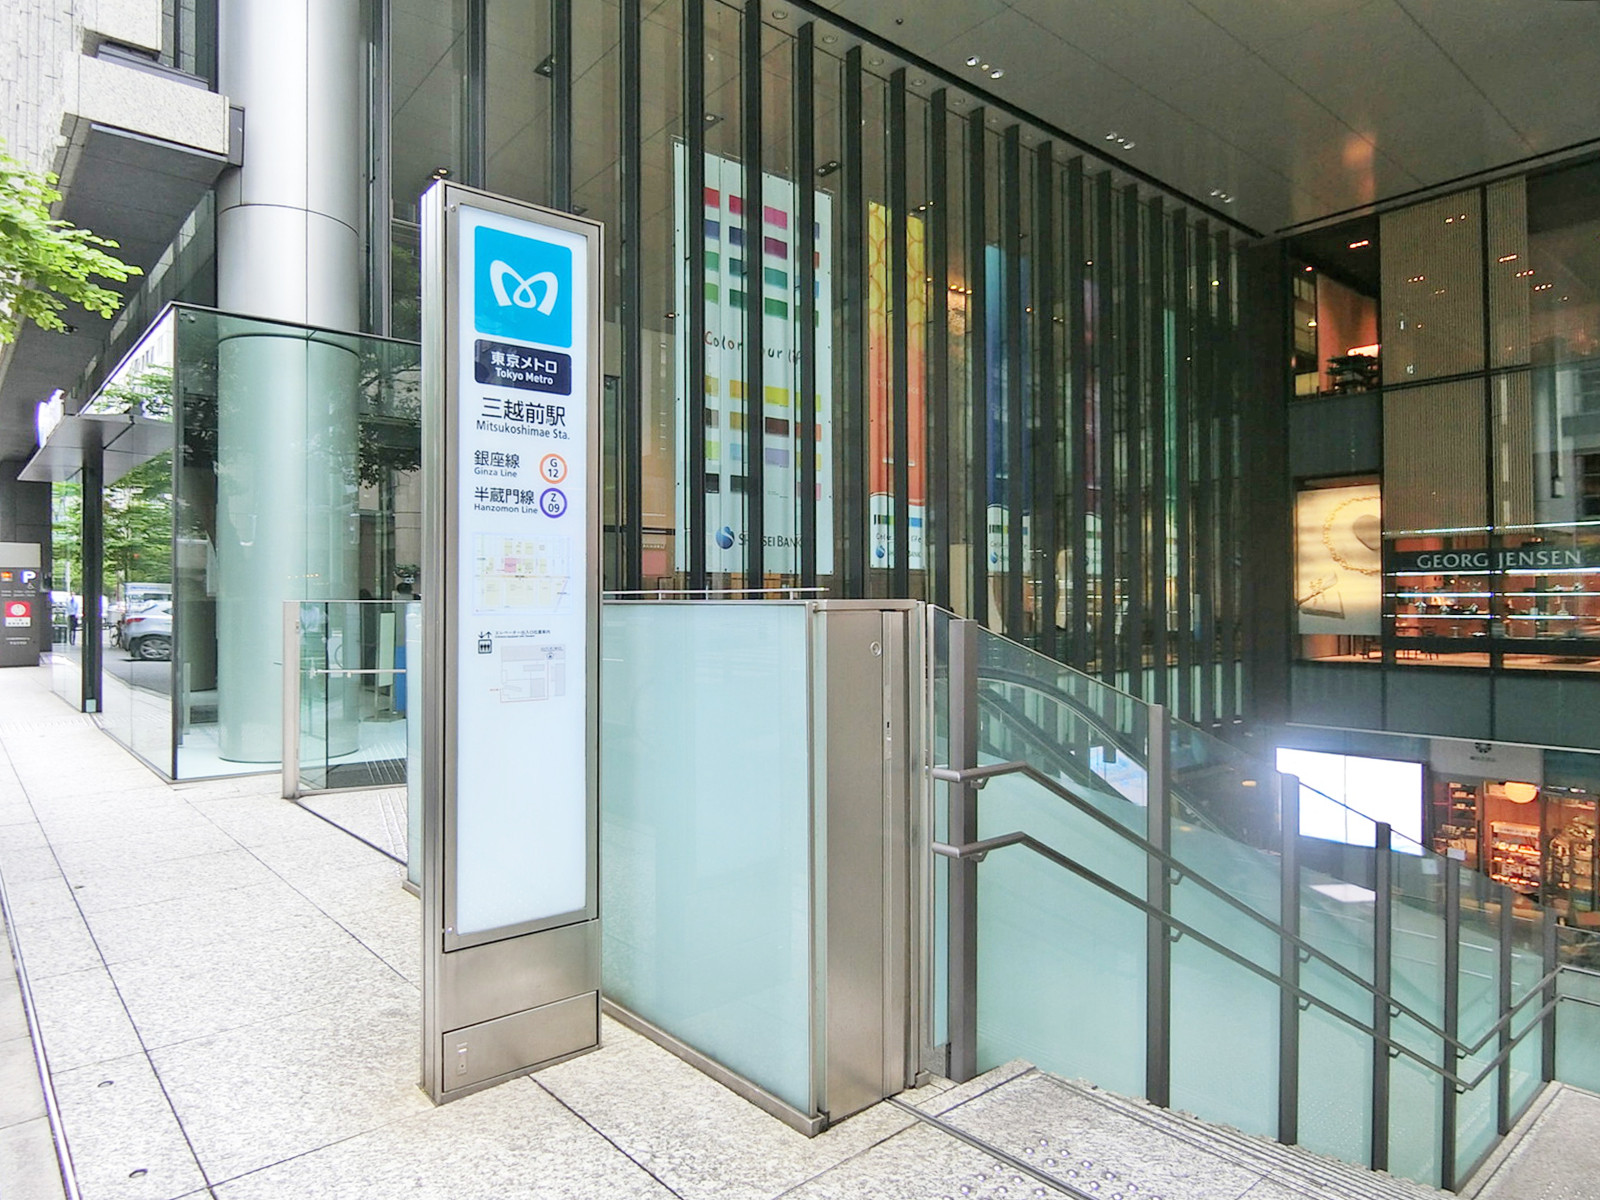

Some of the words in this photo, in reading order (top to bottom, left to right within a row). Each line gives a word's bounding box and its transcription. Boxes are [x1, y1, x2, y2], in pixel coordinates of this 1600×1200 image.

[490, 351, 558, 374] 東京メトロ
[495, 367, 524, 382] Tokyo
[525, 372, 554, 385] Metro
[481, 396, 566, 427] 三越前駅
[476, 420, 551, 438] Mitsukoshimae
[552, 429, 570, 440] Sta.
[474, 449, 520, 469] 銀座線
[549, 458, 558, 468] G
[474, 467, 498, 476] Ginza
[500, 469, 518, 478] Line
[548, 468, 559, 478] 12
[474, 486, 535, 505] 半蔵門線
[550, 493, 557, 502] Z
[474, 504, 520, 513] Hanzomon
[521, 506, 539, 514] Line
[547, 503, 560, 513] 09
[1416, 552, 1489, 569] GEORG
[1497, 549, 1582, 569] JENSEN
[22, 570, 37, 584] P
